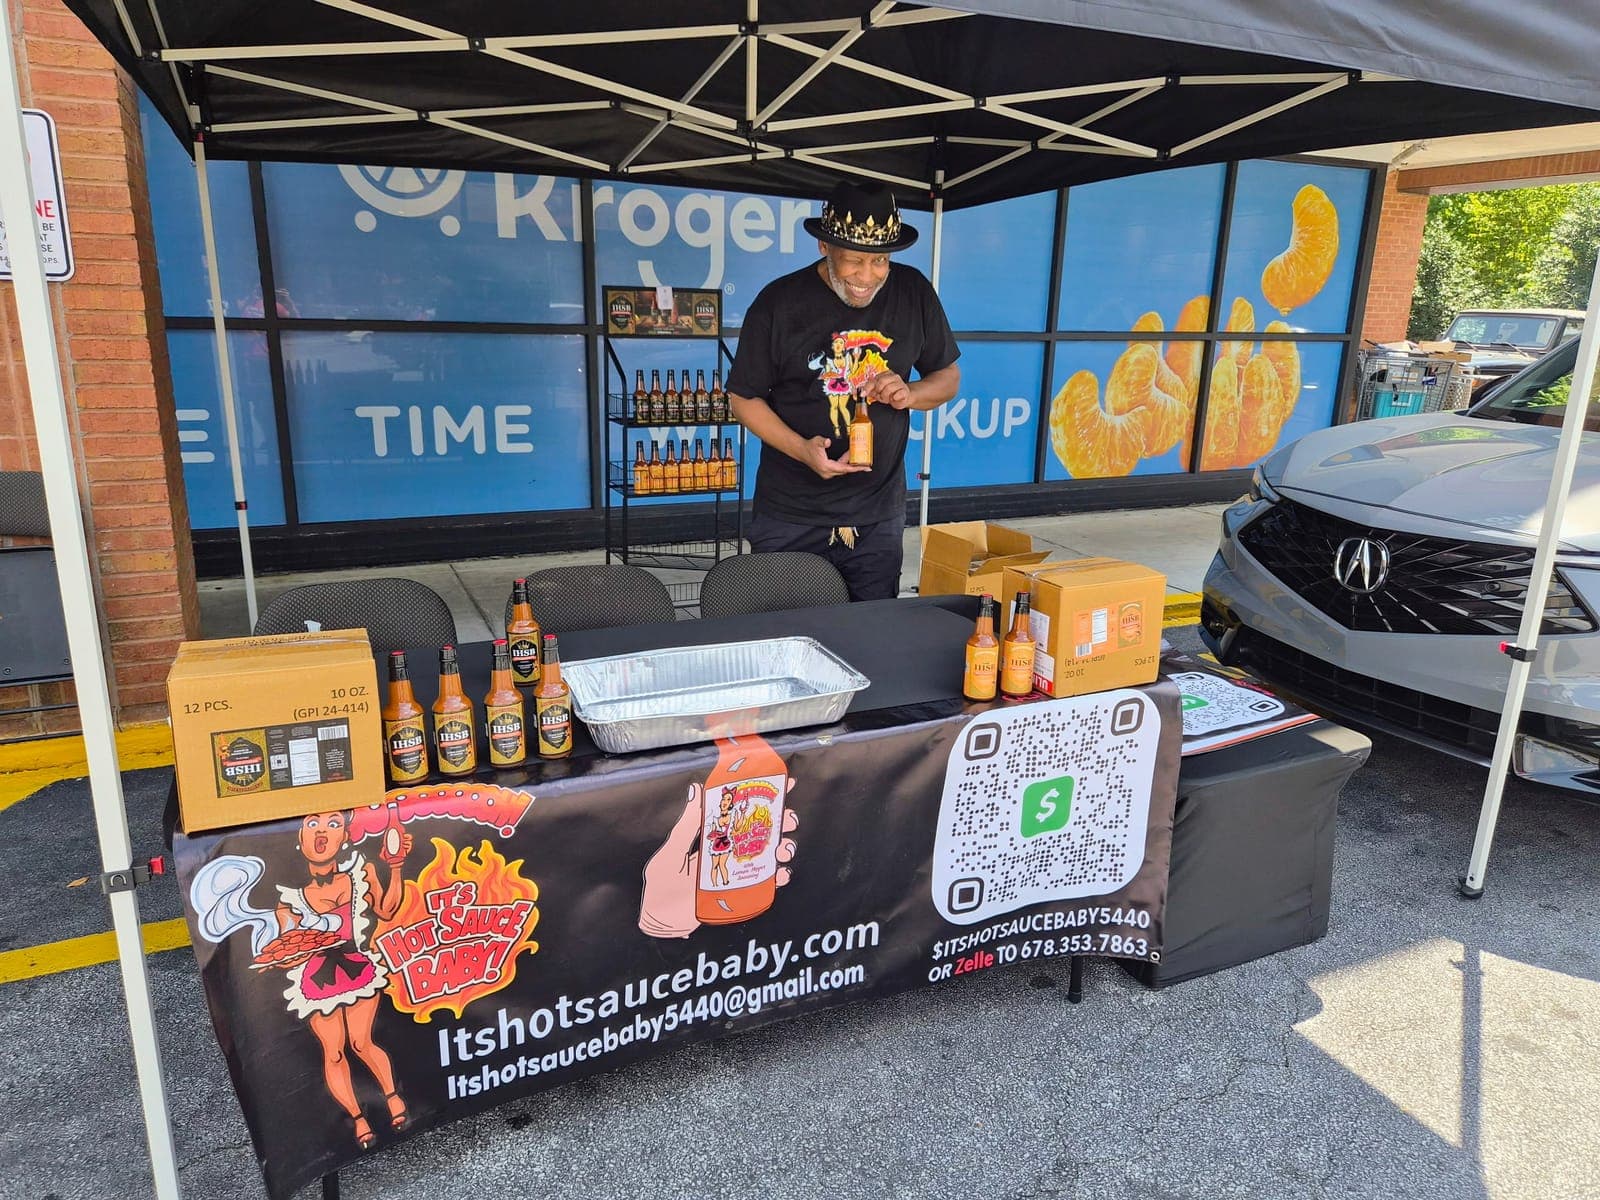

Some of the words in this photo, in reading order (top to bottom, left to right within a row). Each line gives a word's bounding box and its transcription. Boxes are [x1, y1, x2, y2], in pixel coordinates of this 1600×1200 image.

[35, 199, 56, 218] NE
[42, 222, 56, 232] BE
[494, 172, 812, 290] Kroger
[41, 244, 54, 253] SE
[175, 408, 215, 463] E
[355, 405, 534, 457] TIME
[909, 398, 1031, 440] KUP
[331, 689, 346, 699] 10
[349, 686, 369, 697] OZ.
[184, 703, 200, 714] 12
[204, 700, 233, 711] PCS.
[293, 707, 319, 721] (GPI
[322, 701, 369, 716] 24-414)
[492, 721, 521, 734] IHSB
[542, 713, 568, 725] IHSB
[393, 735, 422, 749] IHSB
[440, 729, 469, 742] IHSB
[225, 763, 262, 777] IHSB
[429, 883, 474, 911] IT'S
[380, 920, 436, 969] HOT
[439, 901, 531, 941] SAUCE
[932, 907, 1150, 960] $ITSHOTSAUCEBABY5440
[928, 963, 953, 982] OR
[954, 951, 994, 975] Zelle
[997, 944, 1017, 964] TO
[1021, 933, 1148, 959] 678.353.7863
[407, 940, 511, 1000] BABY!
[438, 920, 880, 1067] Itshotsaucebaby.com
[448, 961, 864, 1100] Itshotsaucebaby5440@gmail.com
